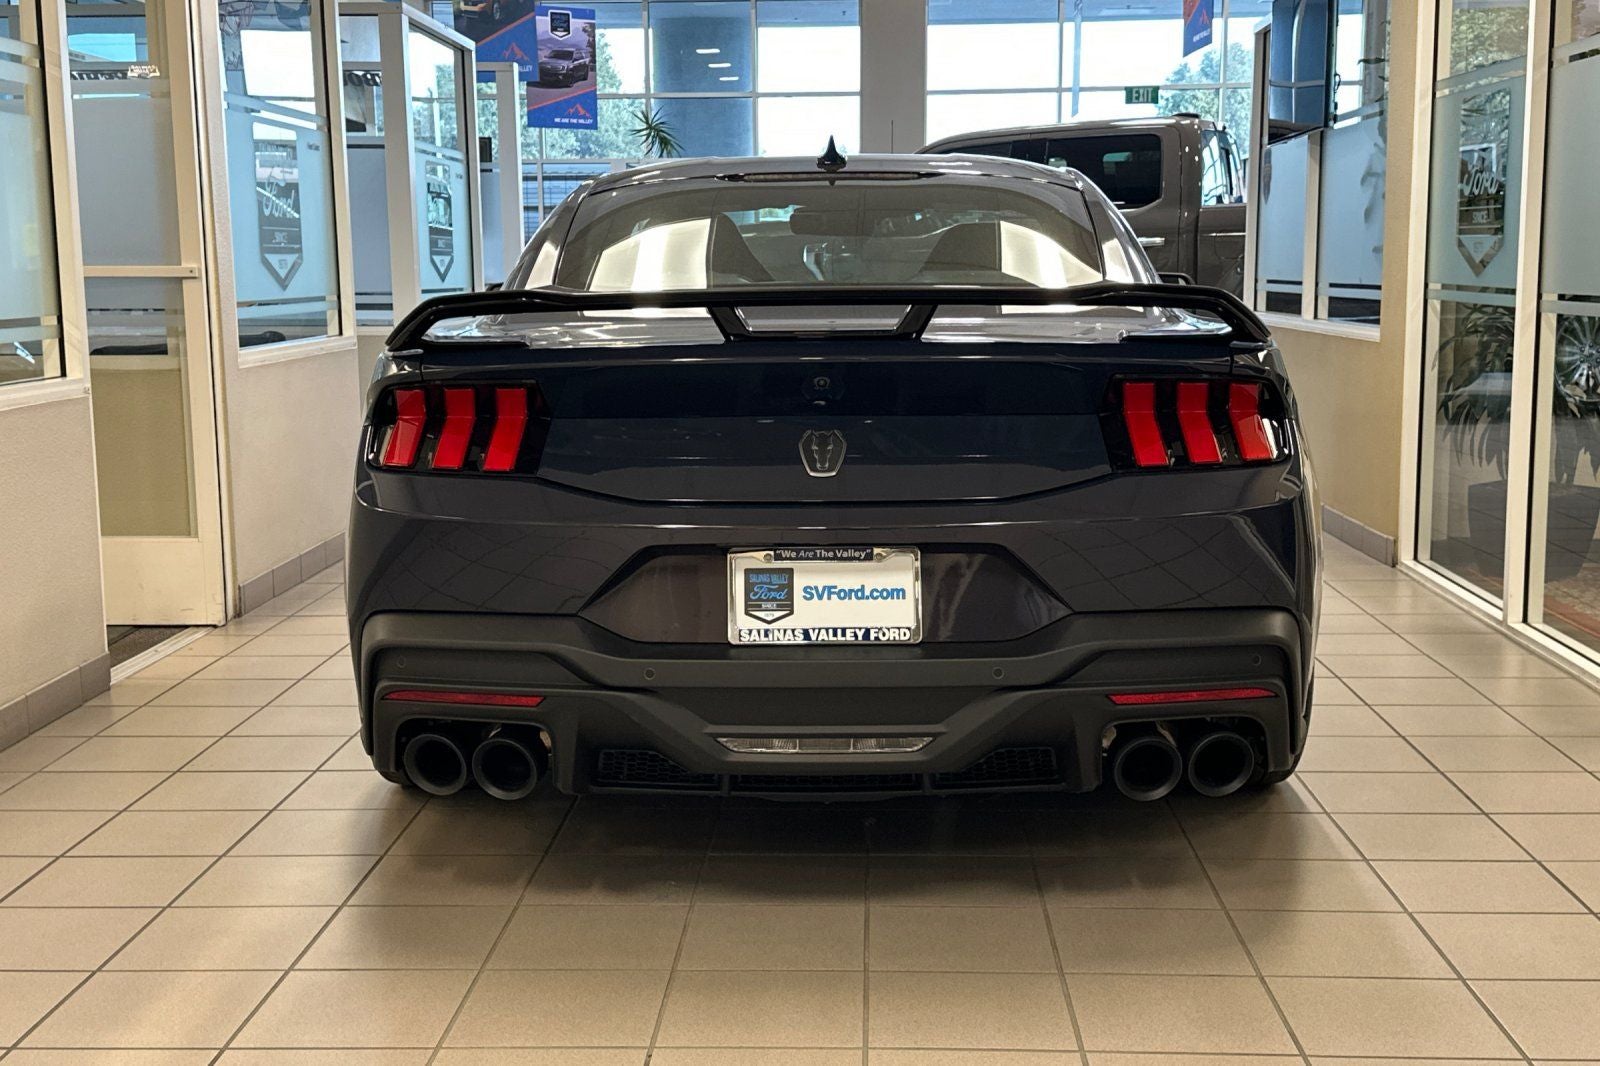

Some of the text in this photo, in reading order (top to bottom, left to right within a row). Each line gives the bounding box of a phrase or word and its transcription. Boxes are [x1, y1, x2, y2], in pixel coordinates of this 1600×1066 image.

[1132, 88, 1153, 103] EXIT
[776, 550, 871, 559] “We Are The Valley”
[749, 573, 789, 584] SALINAS VALLEY
[750, 584, 788, 600] Ford
[802, 584, 906, 601] SVFord.com
[739, 628, 911, 641] SALINAS VALLEY FORD
